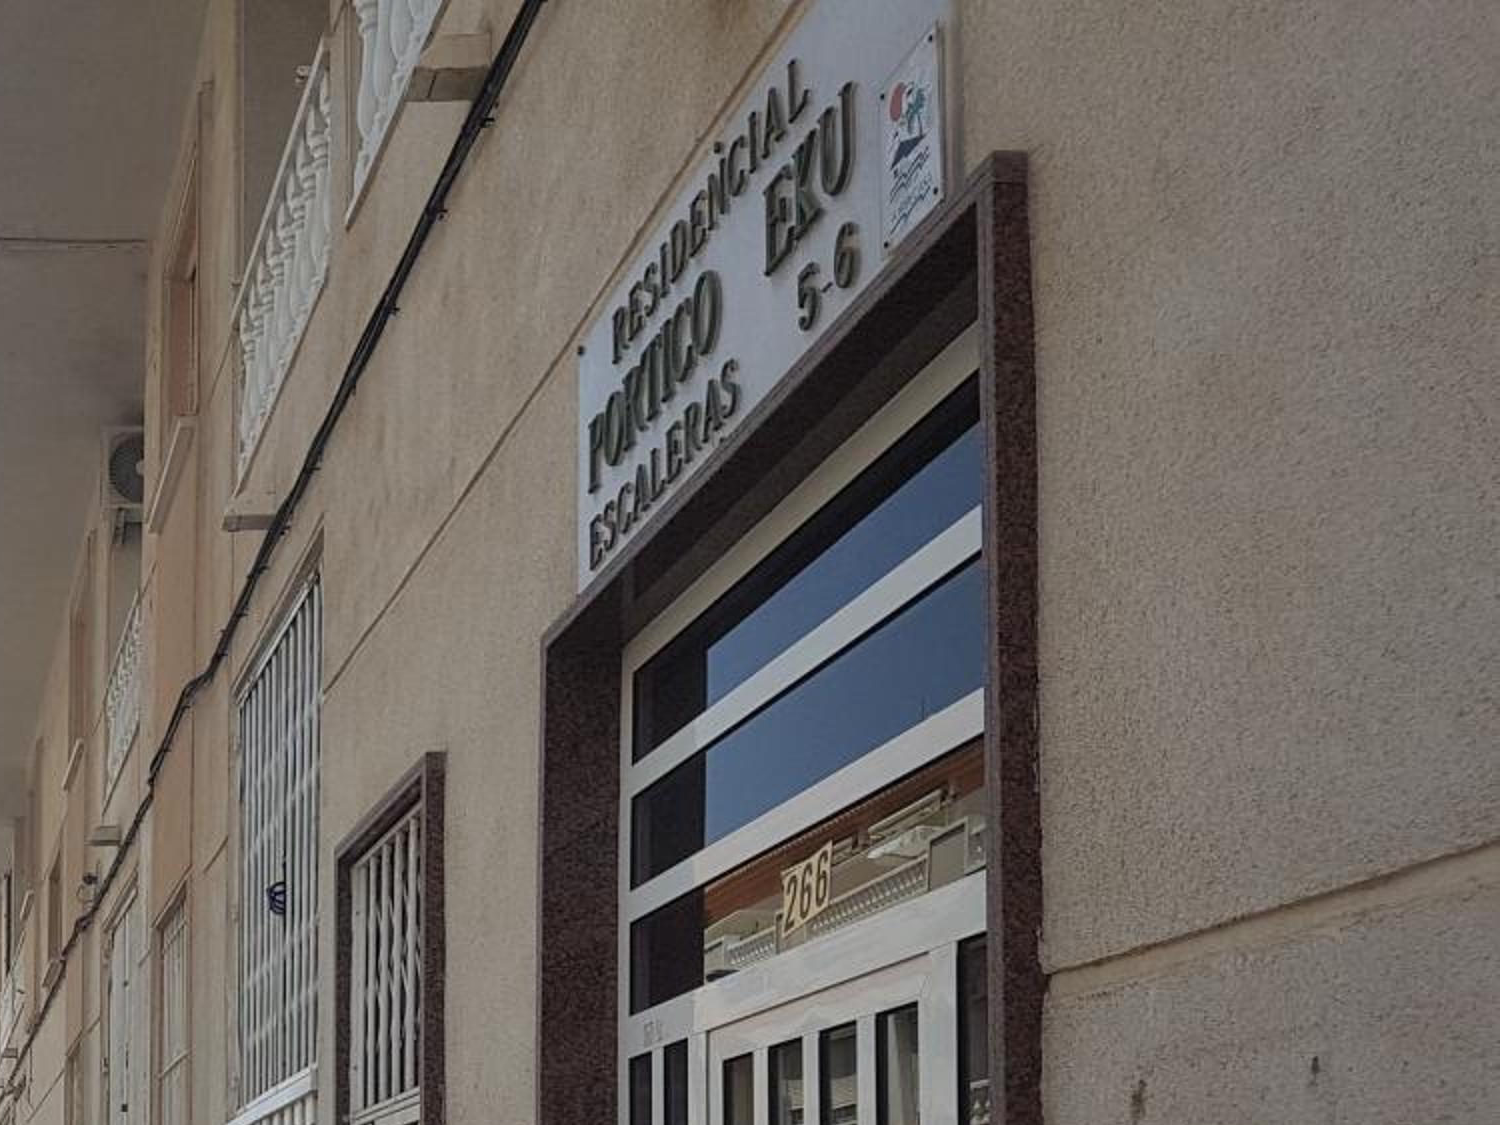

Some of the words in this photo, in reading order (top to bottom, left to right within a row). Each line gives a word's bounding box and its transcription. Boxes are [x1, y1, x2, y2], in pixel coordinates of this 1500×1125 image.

[587, 269, 724, 496] PORTICO
[763, 80, 858, 277] EKU
[611, 57, 812, 365] RESIDENCIAL
[588, 357, 742, 572] ESCALERAS
[797, 220, 861, 332] 5-6
[784, 850, 829, 932] 266
